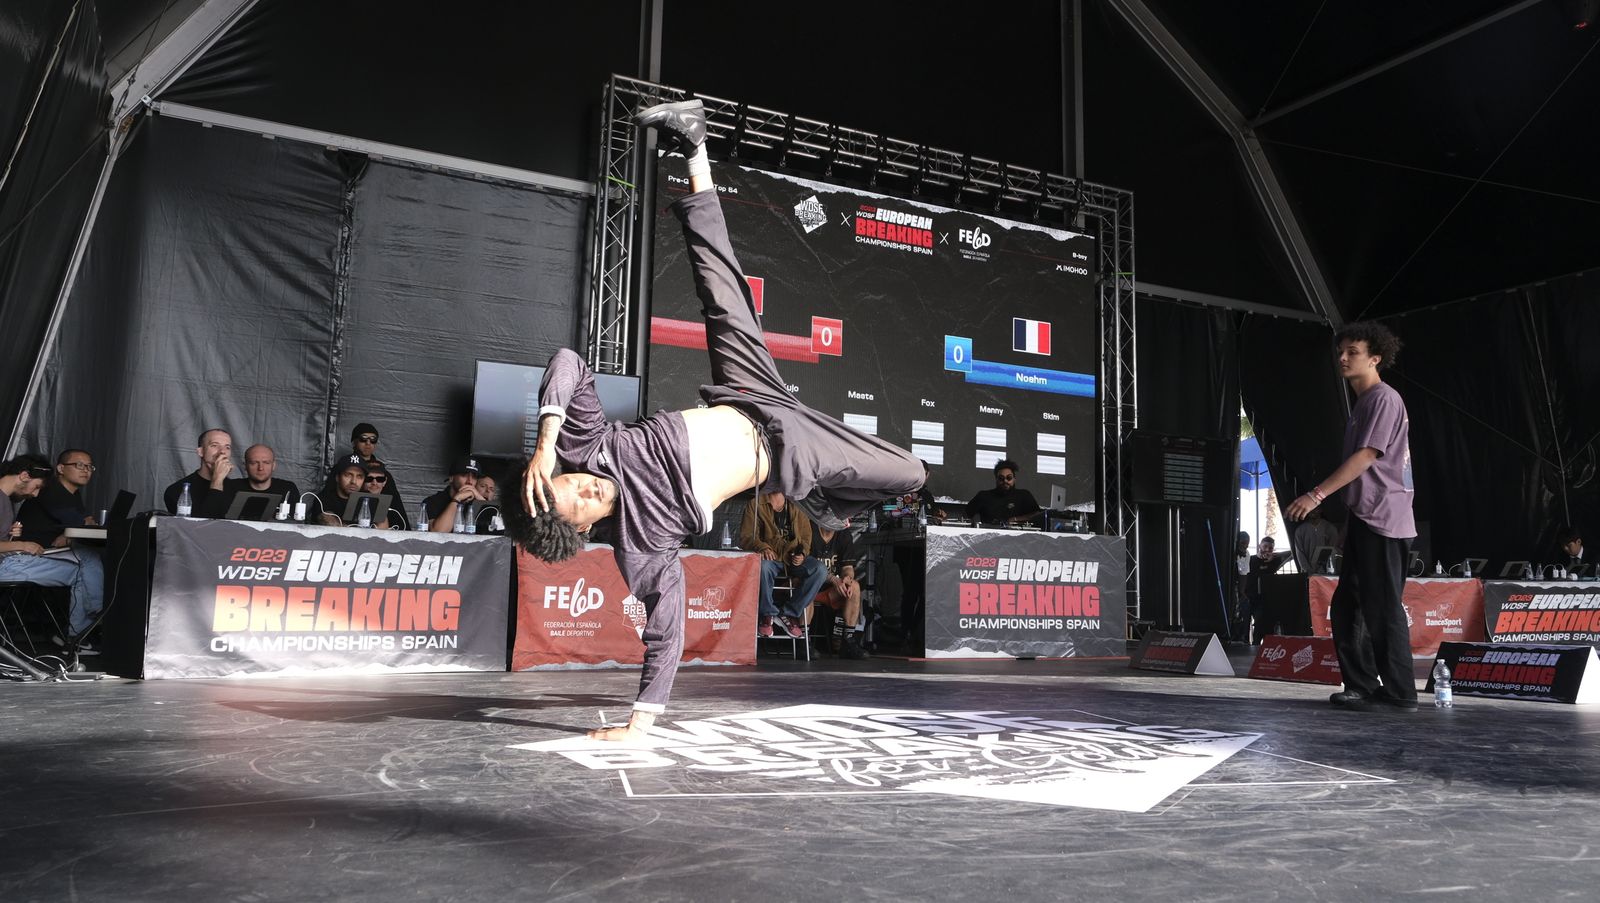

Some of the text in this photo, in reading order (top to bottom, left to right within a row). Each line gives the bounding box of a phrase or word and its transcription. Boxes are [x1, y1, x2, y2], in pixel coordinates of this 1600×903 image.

[667, 175, 690, 185] Pre-Q
[795, 209, 827, 221] BREAKING
[800, 200, 823, 214] WDSF
[855, 207, 933, 231] WDSF EUROPEAN
[855, 217, 933, 248] BREAKING
[855, 235, 933, 256] CHAMPIONSHIPS SPAIN
[821, 326, 833, 347] 0
[953, 345, 964, 364] 0
[921, 398, 935, 408] Fox
[979, 405, 1004, 416] Manny
[230, 547, 288, 564] 2023
[965, 557, 998, 568] 2023
[217, 549, 464, 585] WDSF EUROPEAN
[959, 557, 1099, 584] WDSF EUROPEAN
[959, 582, 1100, 617] BREAKING
[1501, 593, 1600, 610] WDSF EUROPEA
[212, 585, 462, 632] BREAKING
[687, 608, 732, 621] DanceSport
[959, 617, 1100, 630] CHAMPIONSHIPS SPAIN
[1425, 618, 1462, 627] DanceSport
[1494, 610, 1600, 634] BREAKING
[210, 634, 458, 652] CHAMPIONSHIPS SPAIN
[1492, 632, 1570, 643] CHAMPIONSHIPS
[1458, 651, 1561, 667] WDSF EUROPEAN
[1452, 662, 1558, 686] BREAKING
[1450, 680, 1552, 693] CHAMPIONSHIPS SPAIN
